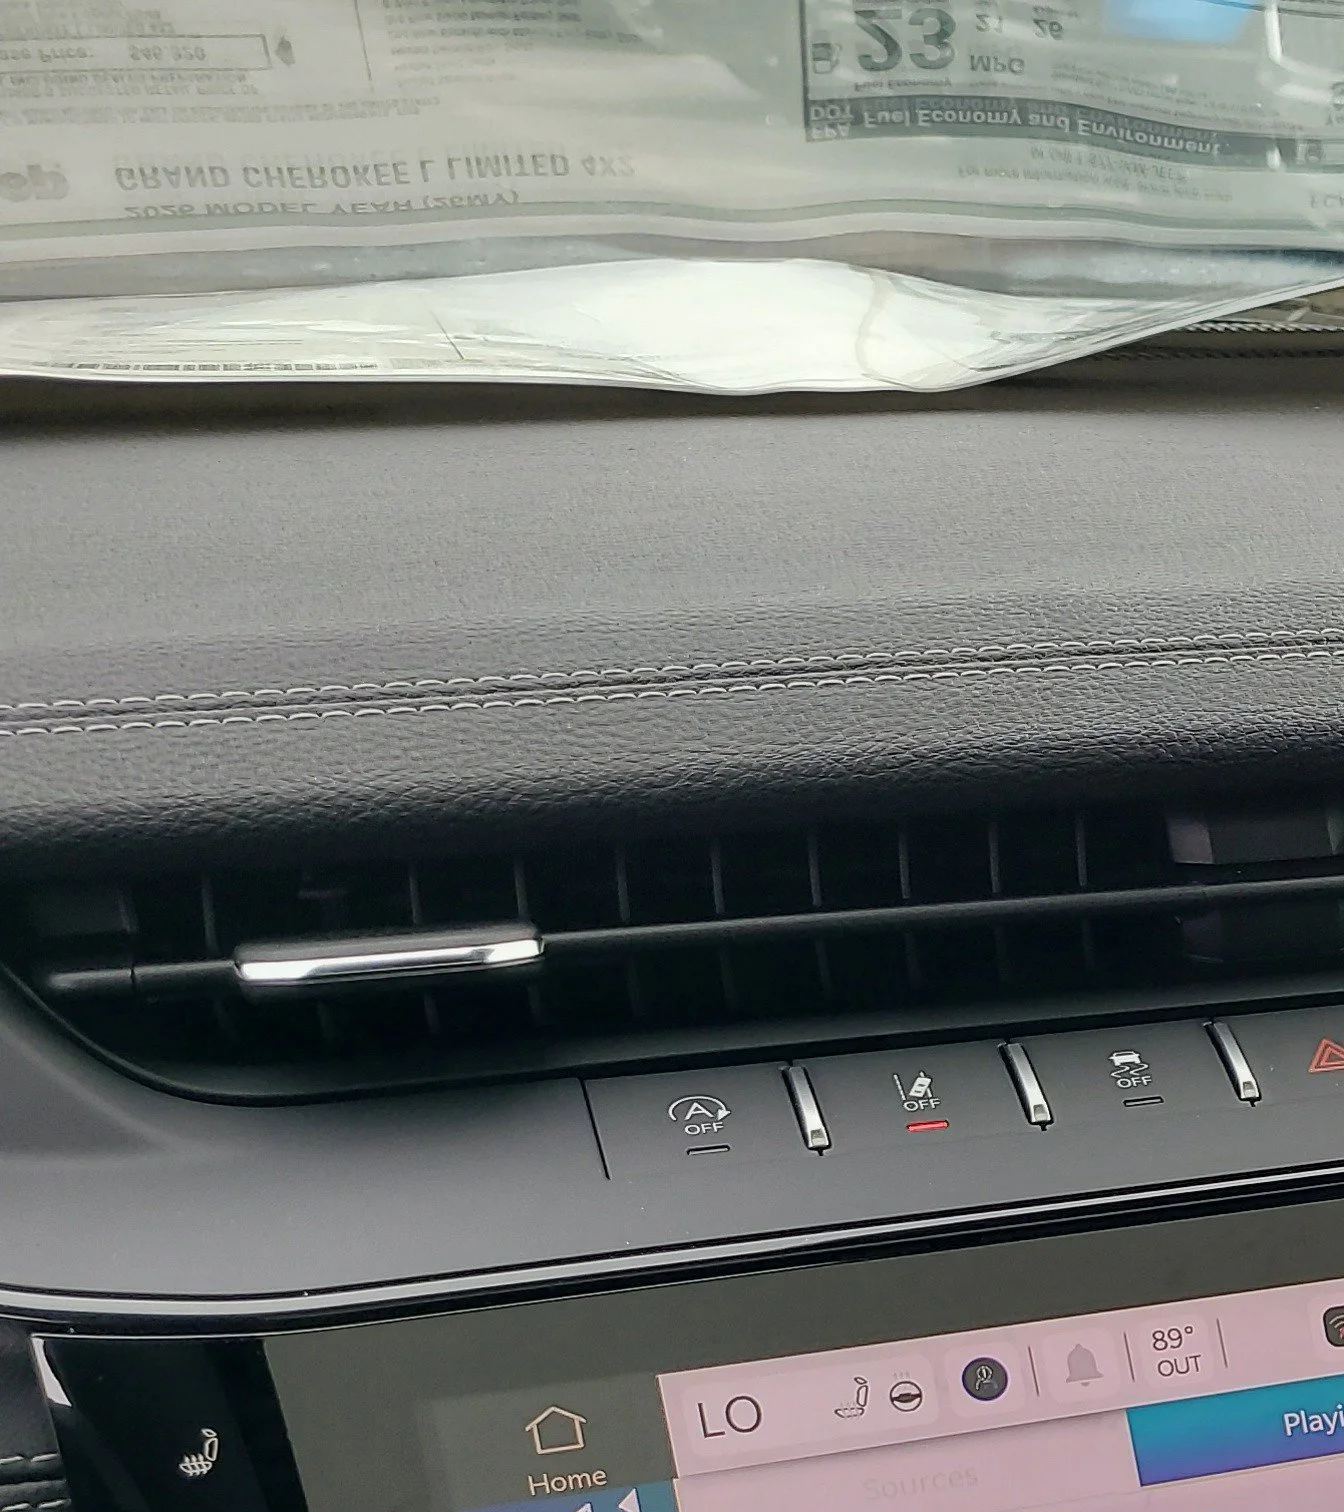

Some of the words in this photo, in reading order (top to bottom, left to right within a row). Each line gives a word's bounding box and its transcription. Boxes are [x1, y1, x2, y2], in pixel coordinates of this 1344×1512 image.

[1115, 1074, 1153, 1090] OFF
[902, 1098, 941, 1114] OFF
[684, 1121, 725, 1136] OFF
[1151, 1324, 1195, 1351] 89°
[1157, 1354, 1202, 1378] OUT
[698, 1395, 763, 1439] LO
[527, 1468, 608, 1497] Home
